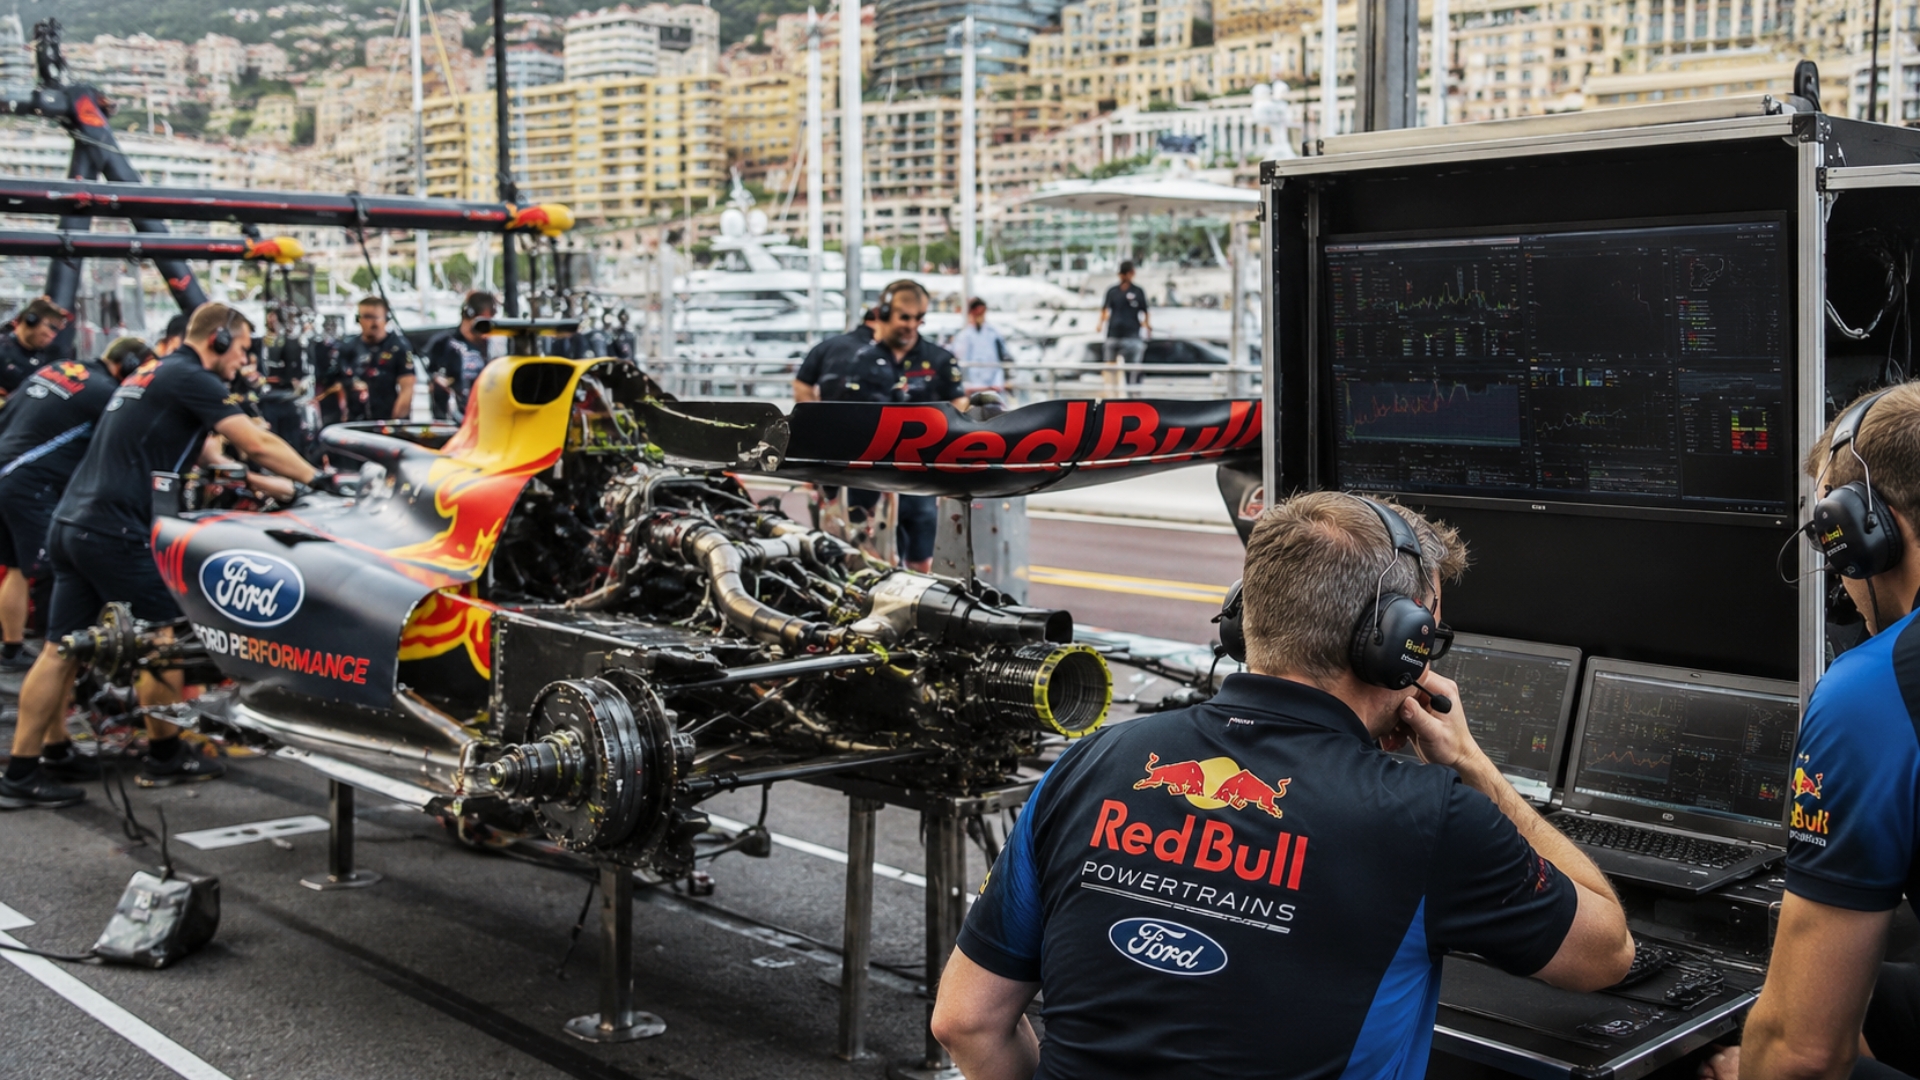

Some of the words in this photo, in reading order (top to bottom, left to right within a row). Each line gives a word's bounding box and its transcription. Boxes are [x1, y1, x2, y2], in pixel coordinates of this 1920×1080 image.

[849, 401, 1088, 473] Red
[216, 555, 285, 617] Ford
[229, 632, 370, 685] PERFORMANCE
[1089, 799, 1197, 865] Red
[1193, 819, 1309, 891] Bull
[1081, 861, 1296, 922] POWERTRAINS
[1127, 923, 1205, 970] Ford
